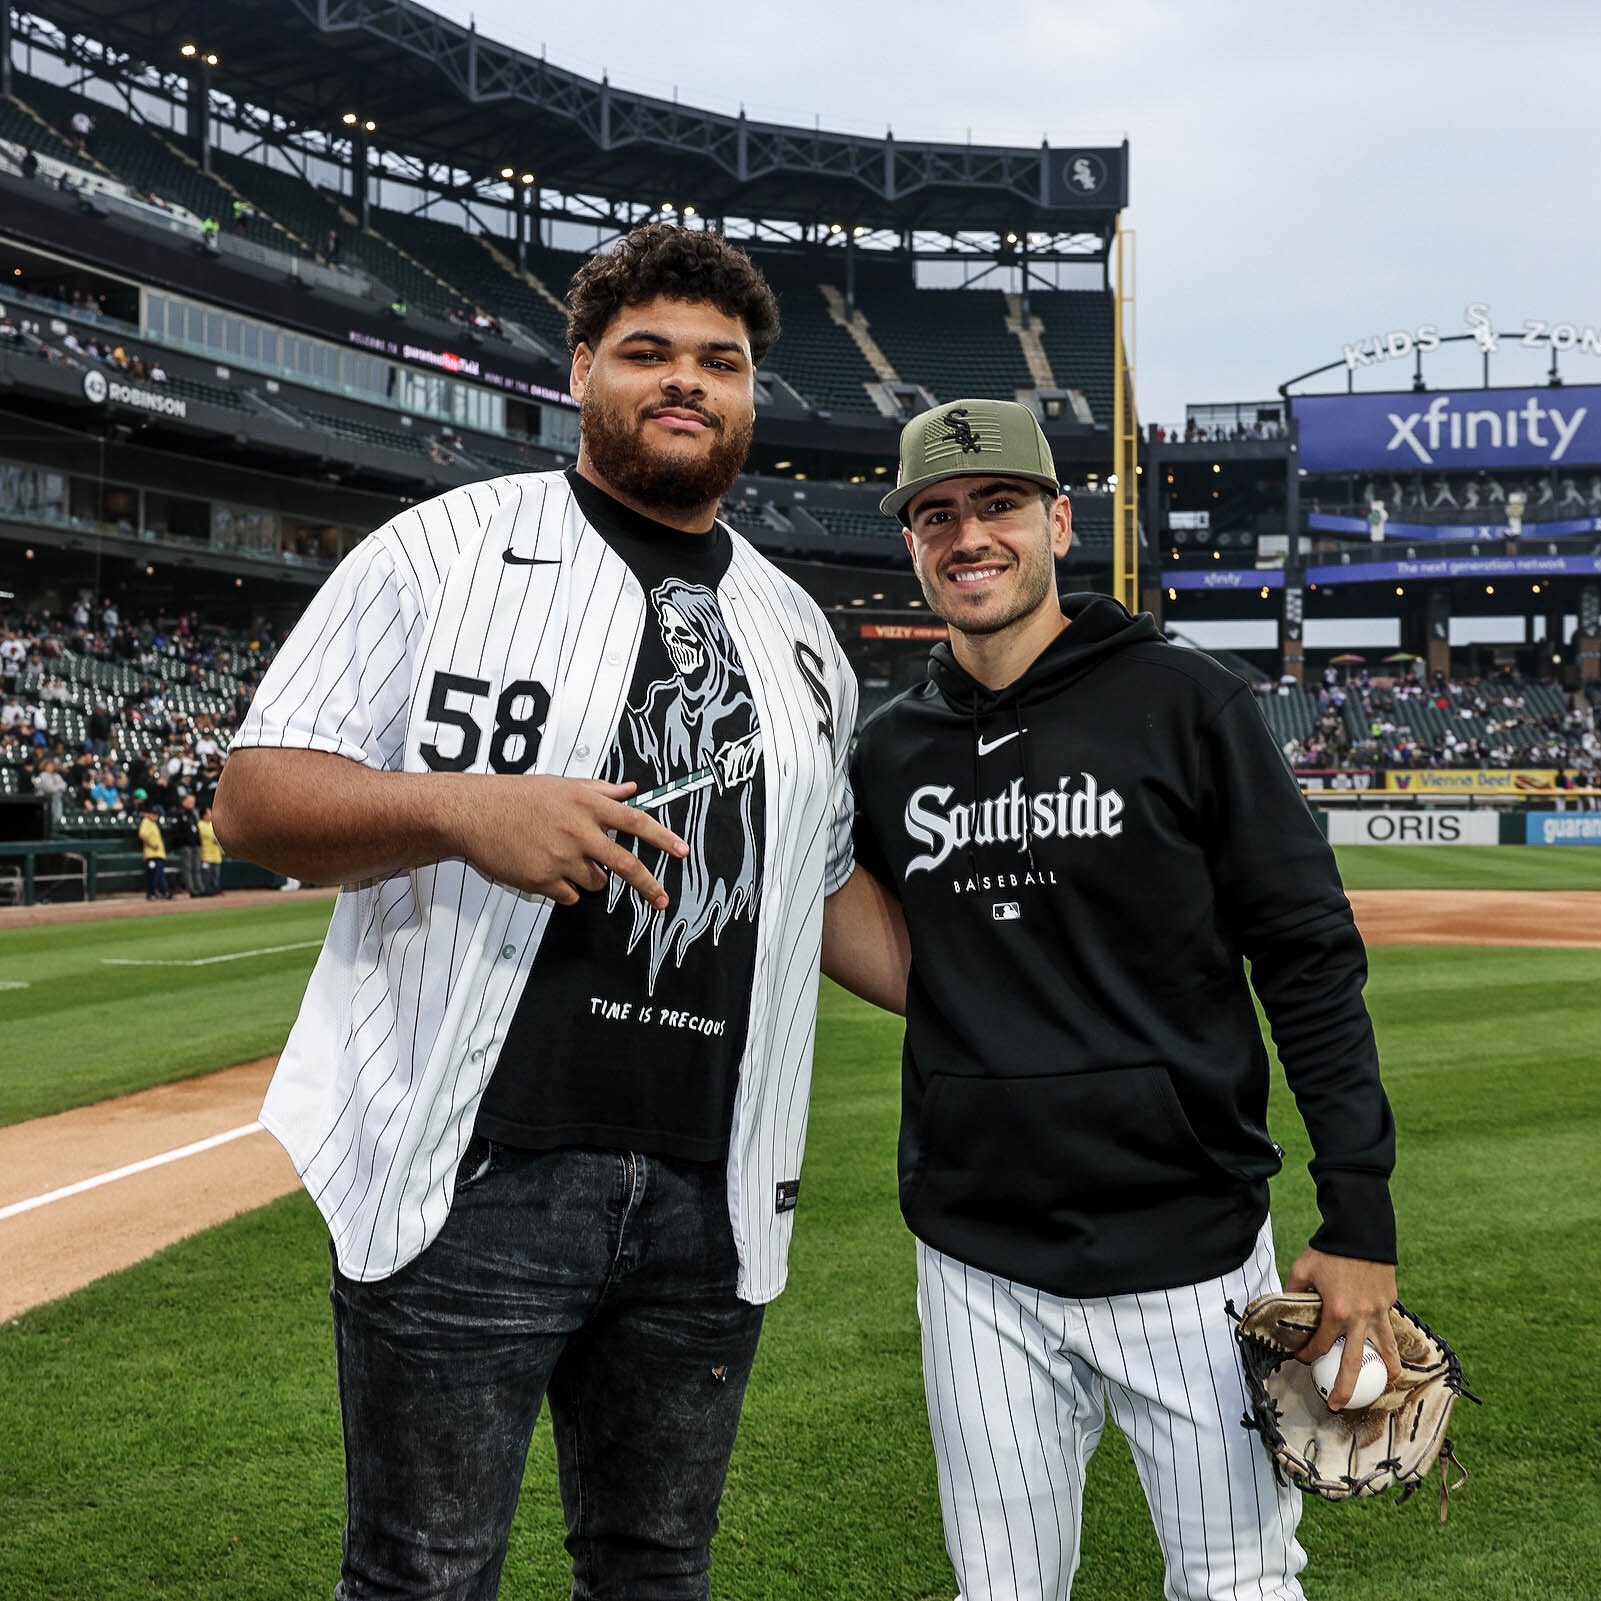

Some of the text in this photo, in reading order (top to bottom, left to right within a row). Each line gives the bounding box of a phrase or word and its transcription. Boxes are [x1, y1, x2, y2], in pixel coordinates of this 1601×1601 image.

[1343, 325, 1440, 370] KIDS
[109, 382, 187, 418] ROBINSON
[1387, 397, 1587, 463] xfinity
[1204, 572, 1242, 587] xfinity
[1397, 558, 1567, 576] The next generation network
[419, 670, 552, 775] 58
[1419, 774, 1511, 788] Vienna Beef
[904, 771, 1125, 881] Southside
[1366, 814, 1462, 841] ORIS
[953, 870, 1057, 894] BASEBALL
[591, 998, 726, 1036] TIME IS PRECIOUS
